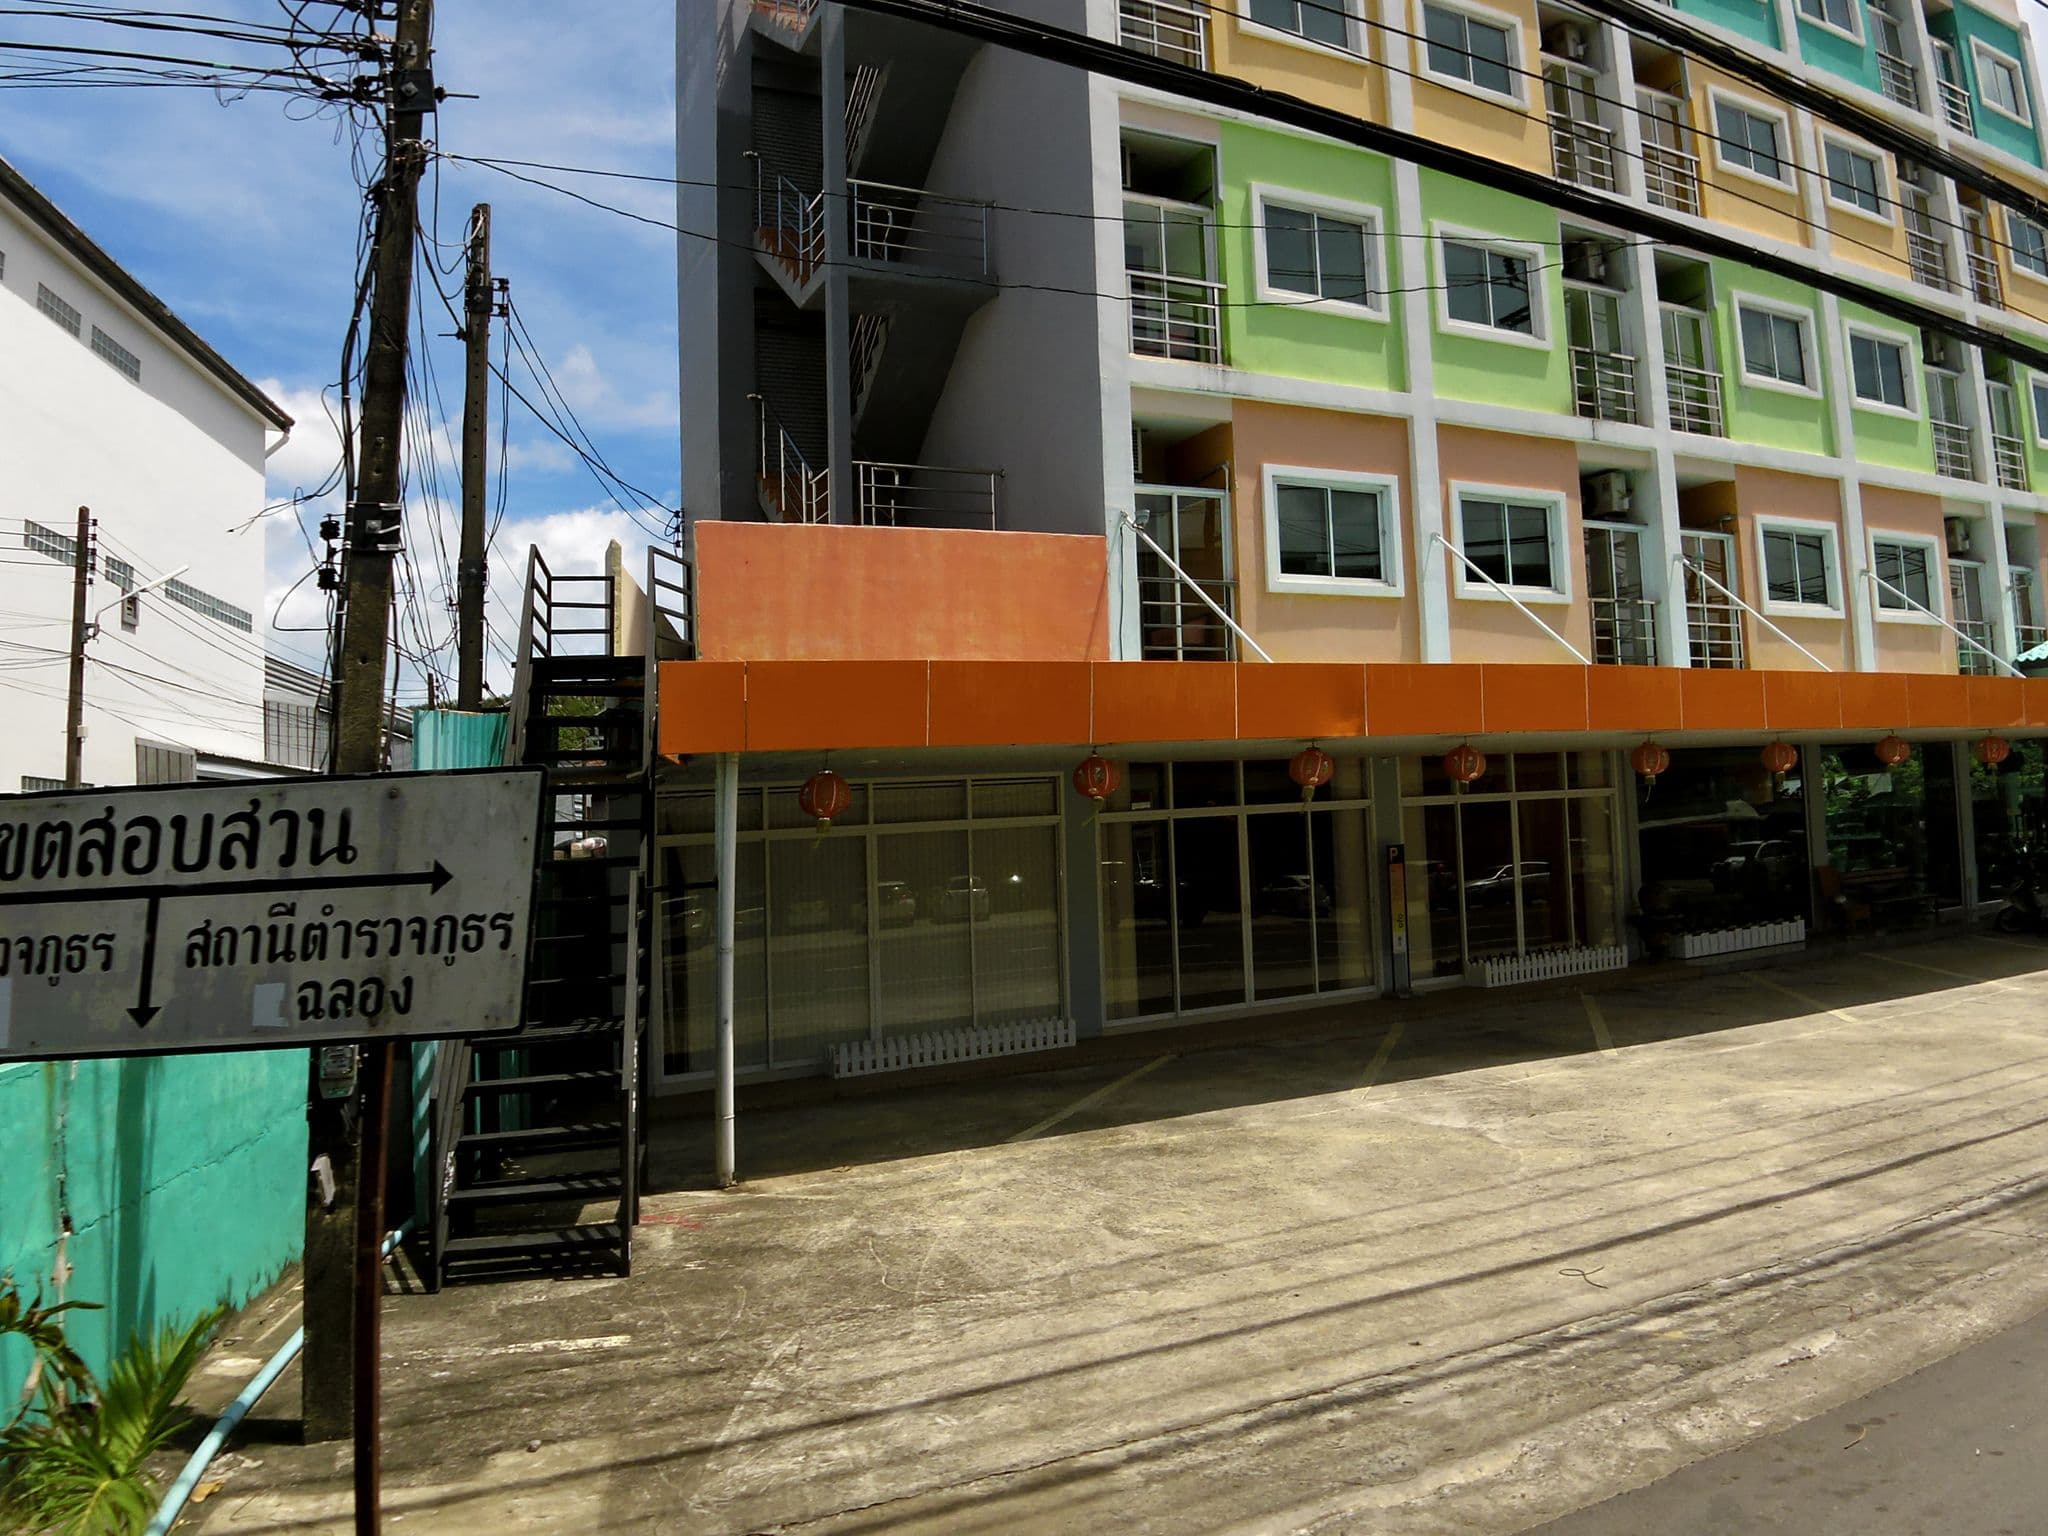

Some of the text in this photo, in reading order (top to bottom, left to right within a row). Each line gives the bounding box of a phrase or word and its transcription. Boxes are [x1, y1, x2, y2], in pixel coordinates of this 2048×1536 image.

[185, 902, 515, 968] สถานีตำรวจภูธร
[296, 975, 414, 1021] ฉลอง
